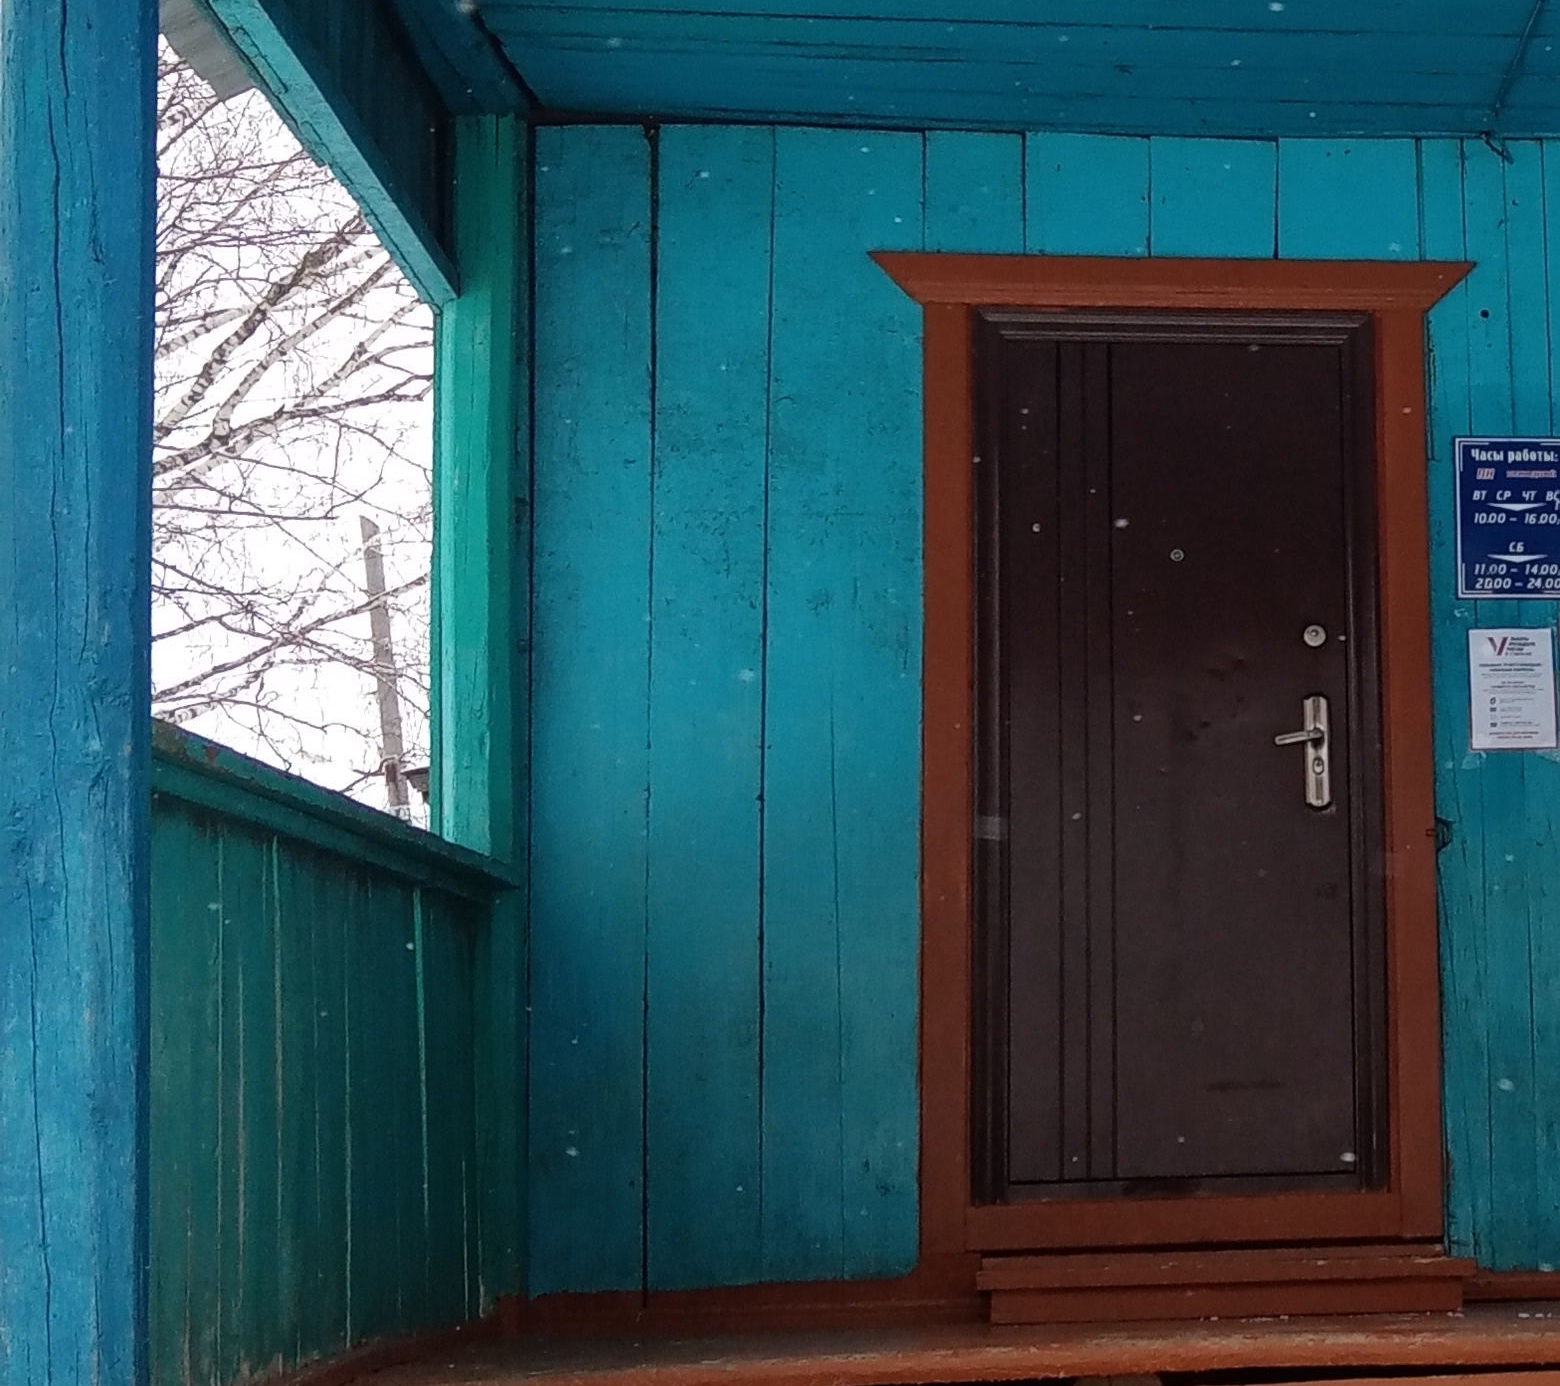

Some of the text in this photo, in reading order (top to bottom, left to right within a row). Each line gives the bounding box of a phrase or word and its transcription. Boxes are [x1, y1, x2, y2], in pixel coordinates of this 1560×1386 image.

[1470, 448, 1559, 464] Часы работы:
[1472, 490, 1560, 501] ВТ СР ЧТ ВС
[1508, 541, 1525, 552] СБ
